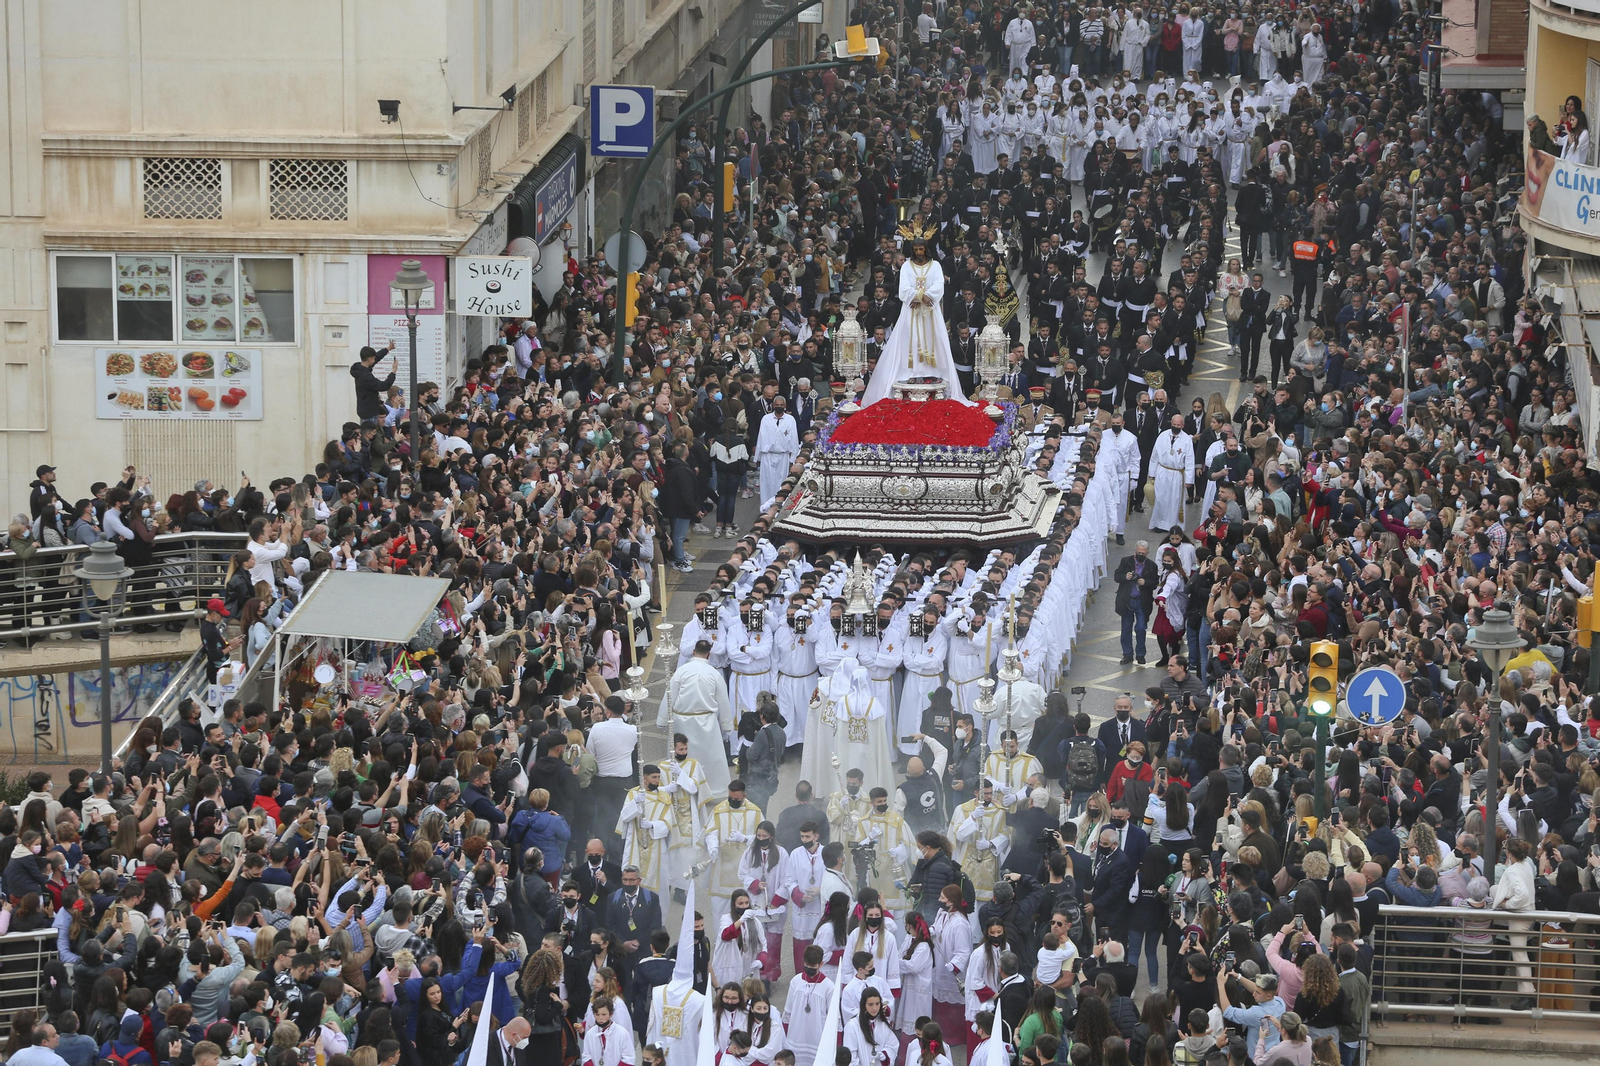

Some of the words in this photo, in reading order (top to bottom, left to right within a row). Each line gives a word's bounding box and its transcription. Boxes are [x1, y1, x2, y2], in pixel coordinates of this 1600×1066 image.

[599, 88, 646, 142] P
[468, 260, 523, 281] Sushi
[467, 296, 522, 316] House
